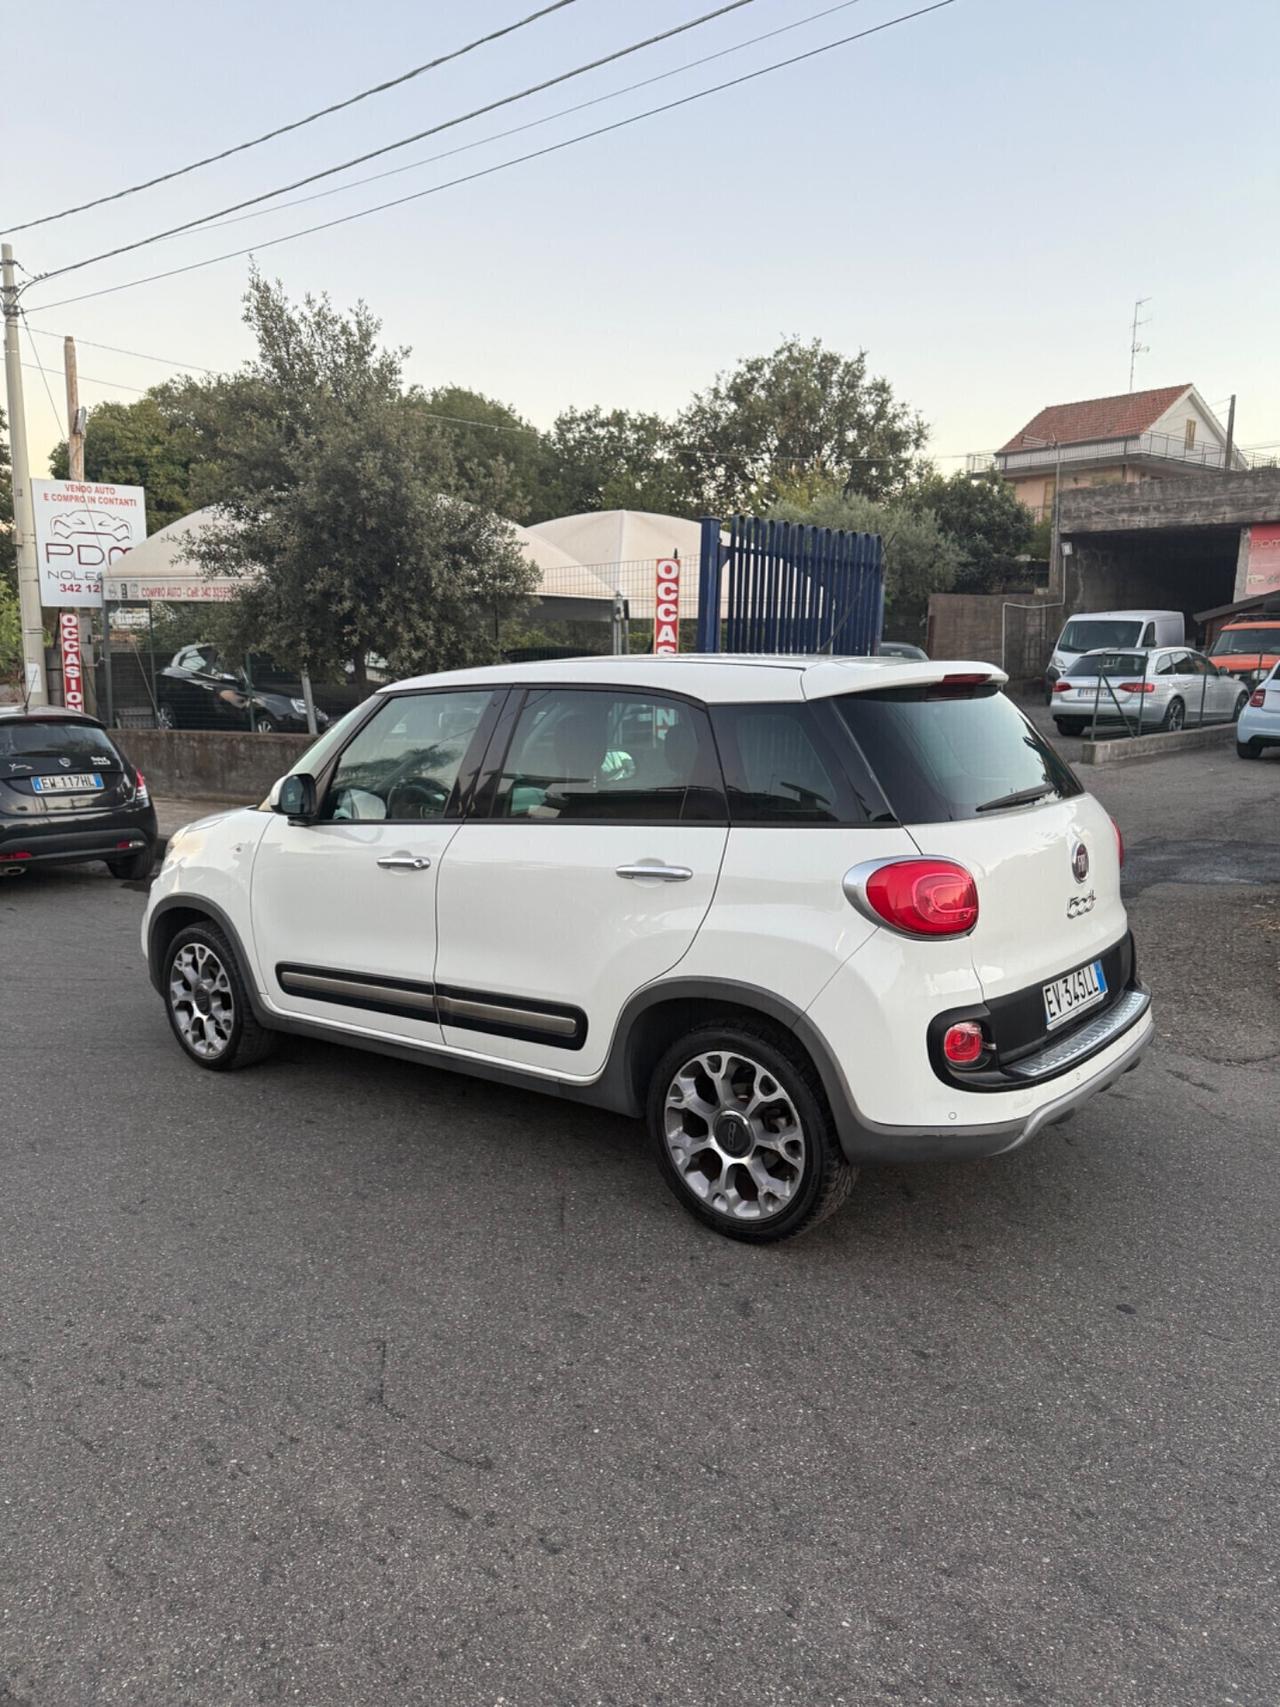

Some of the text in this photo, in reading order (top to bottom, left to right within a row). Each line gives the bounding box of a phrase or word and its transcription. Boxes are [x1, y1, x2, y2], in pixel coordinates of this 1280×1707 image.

[64, 484, 116, 495] VENDO AUTO
[43, 493, 137, 507] E COMPRO IN CONTANTI
[59, 584, 82, 593] 342
[1044, 966, 1099, 1018] EV 345LL
